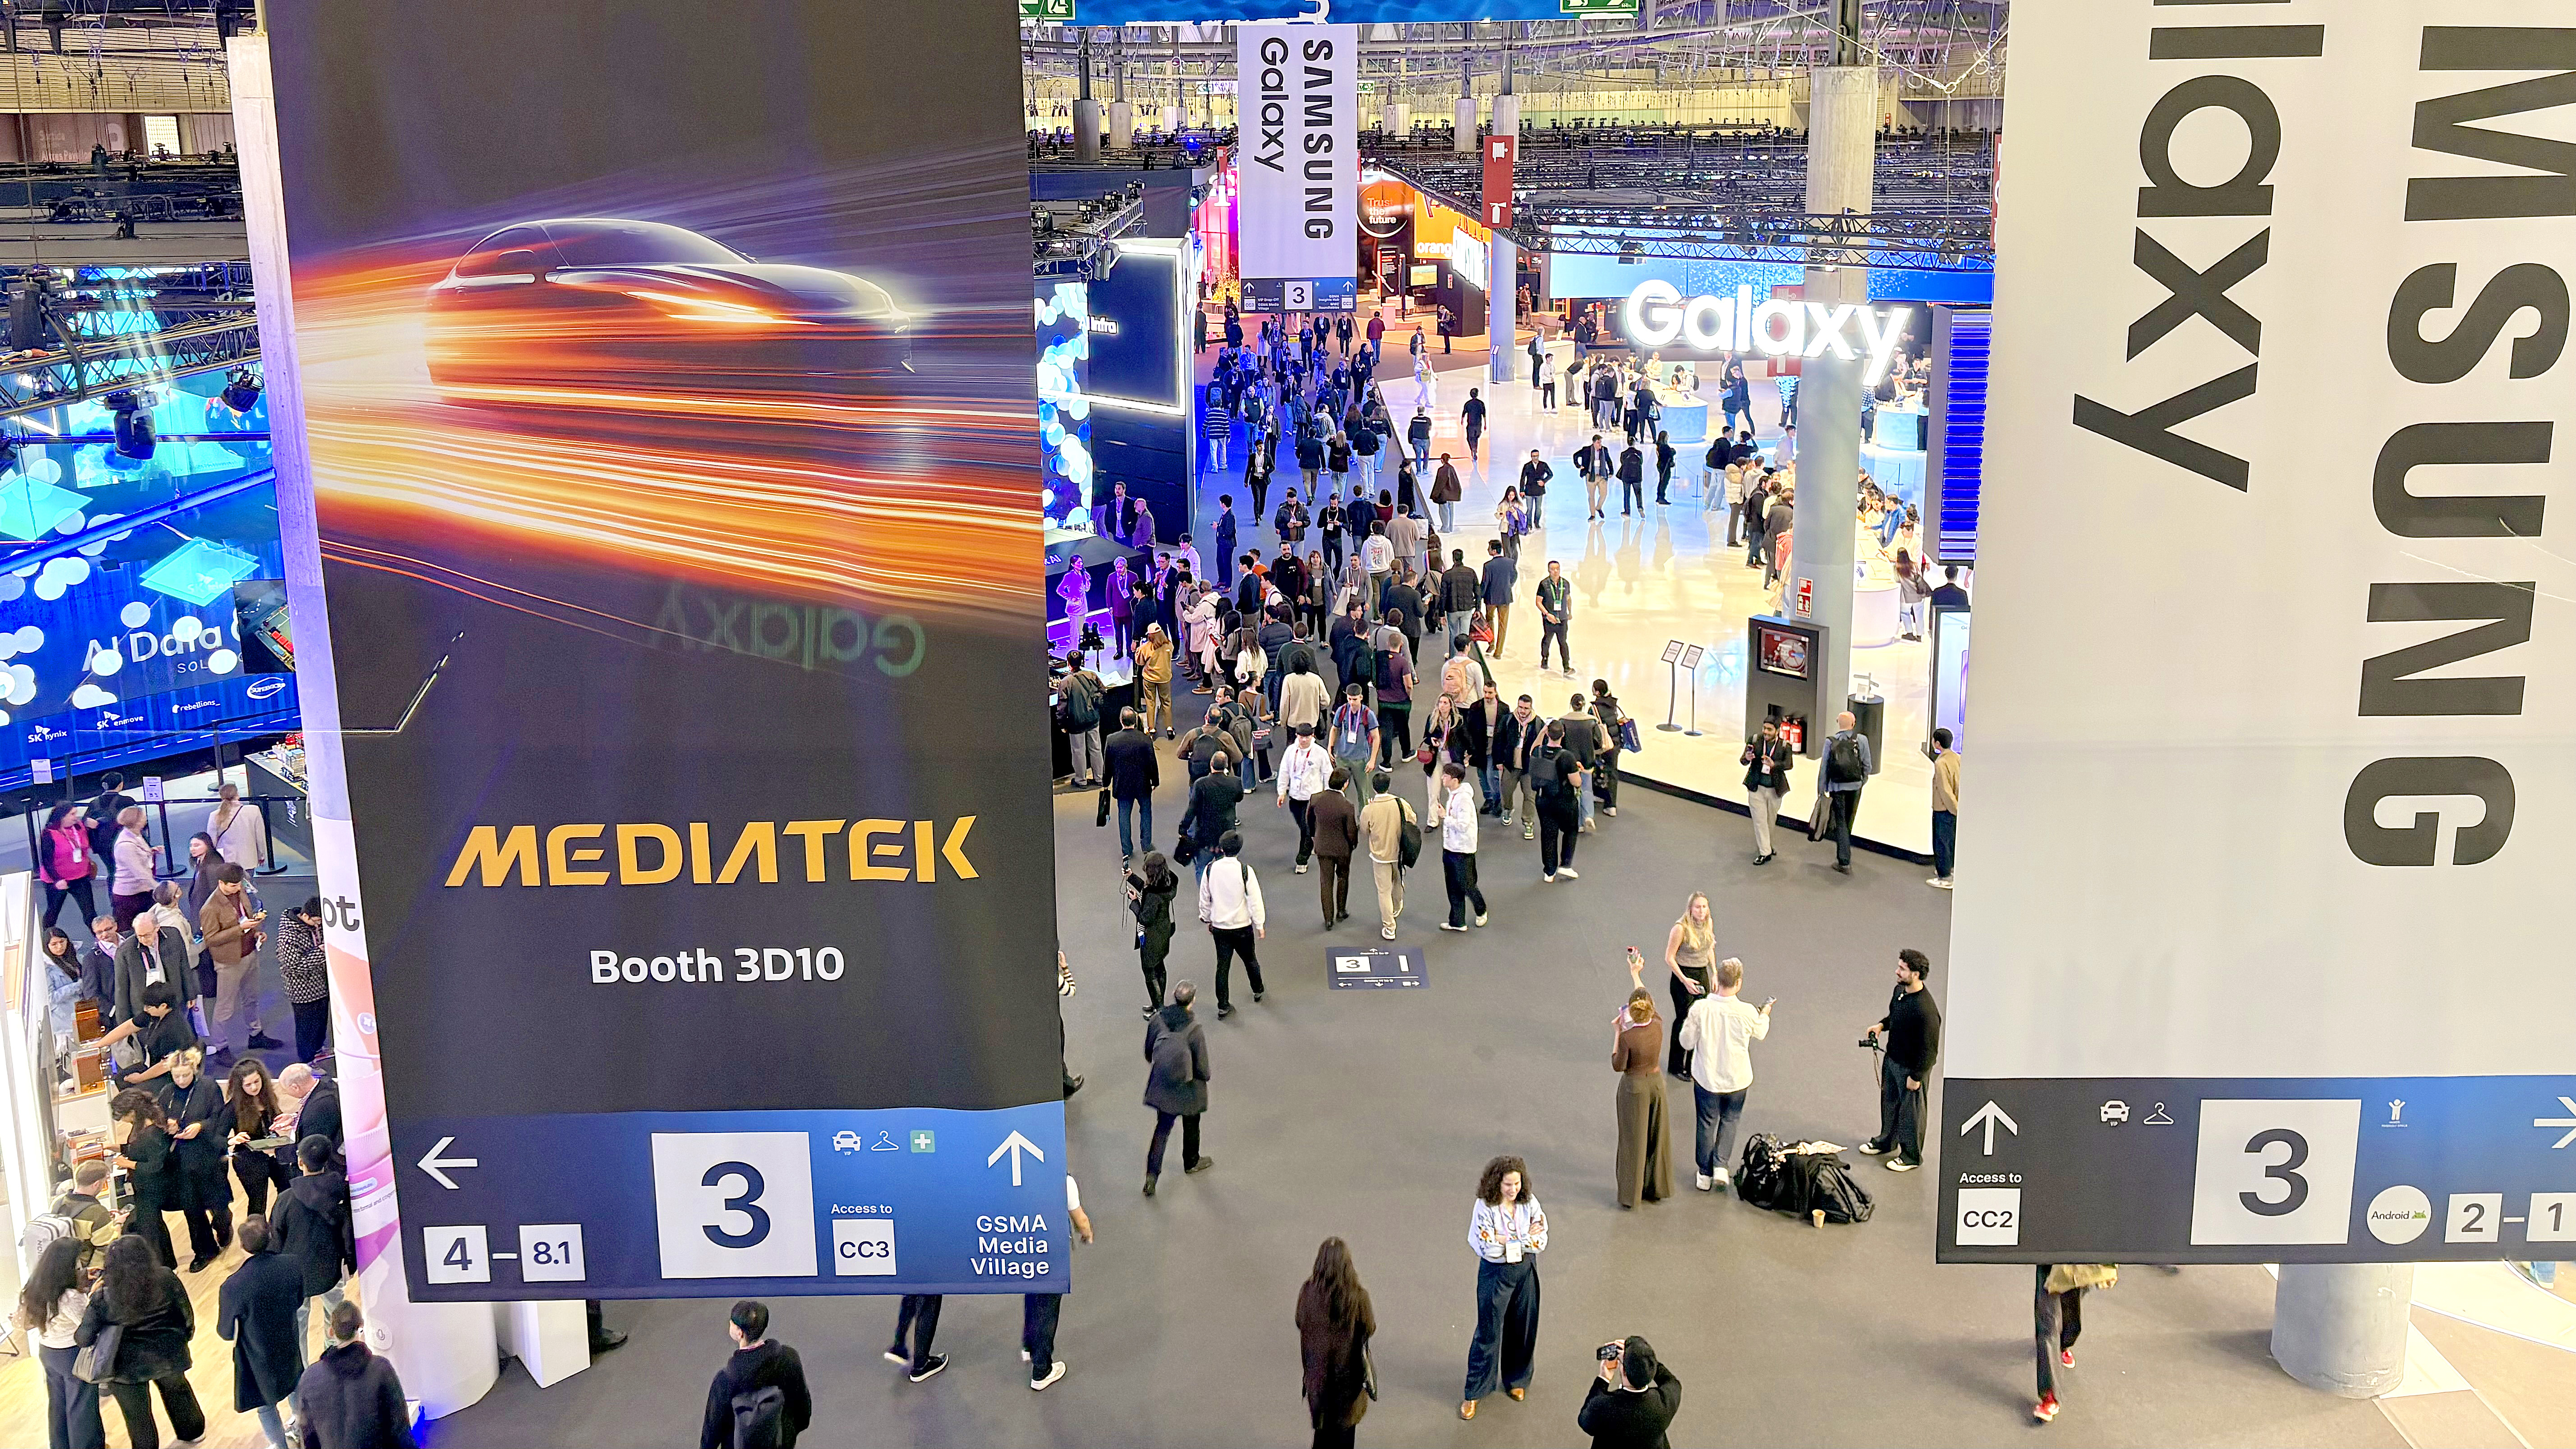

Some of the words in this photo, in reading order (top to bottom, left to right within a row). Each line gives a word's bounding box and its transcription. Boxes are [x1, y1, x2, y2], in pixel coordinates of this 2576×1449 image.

[1254, 37, 1289, 172] Galaxy
[1303, 39, 1333, 239] SAMSUNG
[1369, 207, 1385, 215] the
[1417, 242, 1453, 258] orang
[2073, 0, 2325, 492] laxy
[1293, 287, 1305, 304] 3
[1626, 279, 1911, 387] Galaxy
[97, 719, 109, 730] SK
[113, 716, 144, 726] enmove
[28, 734, 43, 743] SK
[45, 730, 68, 741] hynix
[445, 815, 980, 887] MEDIATEK
[590, 948, 723, 983] Booth
[734, 947, 844, 981] 3D10
[1346, 959, 1361, 968] 3
[1959, 1173, 2005, 1183] Access
[2008, 1173, 2022, 1183] to
[2239, 1128, 2309, 1216] 3
[701, 1161, 771, 1249] 3
[831, 1204, 876, 1214] Access
[879, 1204, 892, 1214] to
[976, 1214, 1048, 1233] GSMA
[1964, 1210, 2013, 1228] CC2
[2371, 1210, 2410, 1220] Android
[2461, 1203, 2484, 1233] 2
[2548, 1202, 2562, 1232] 1
[443, 1237, 473, 1271] 4
[534, 1241, 570, 1265] 8.1
[840, 1241, 889, 1259] CC3
[979, 1236, 1048, 1254] Media
[970, 1257, 1049, 1279] Village
